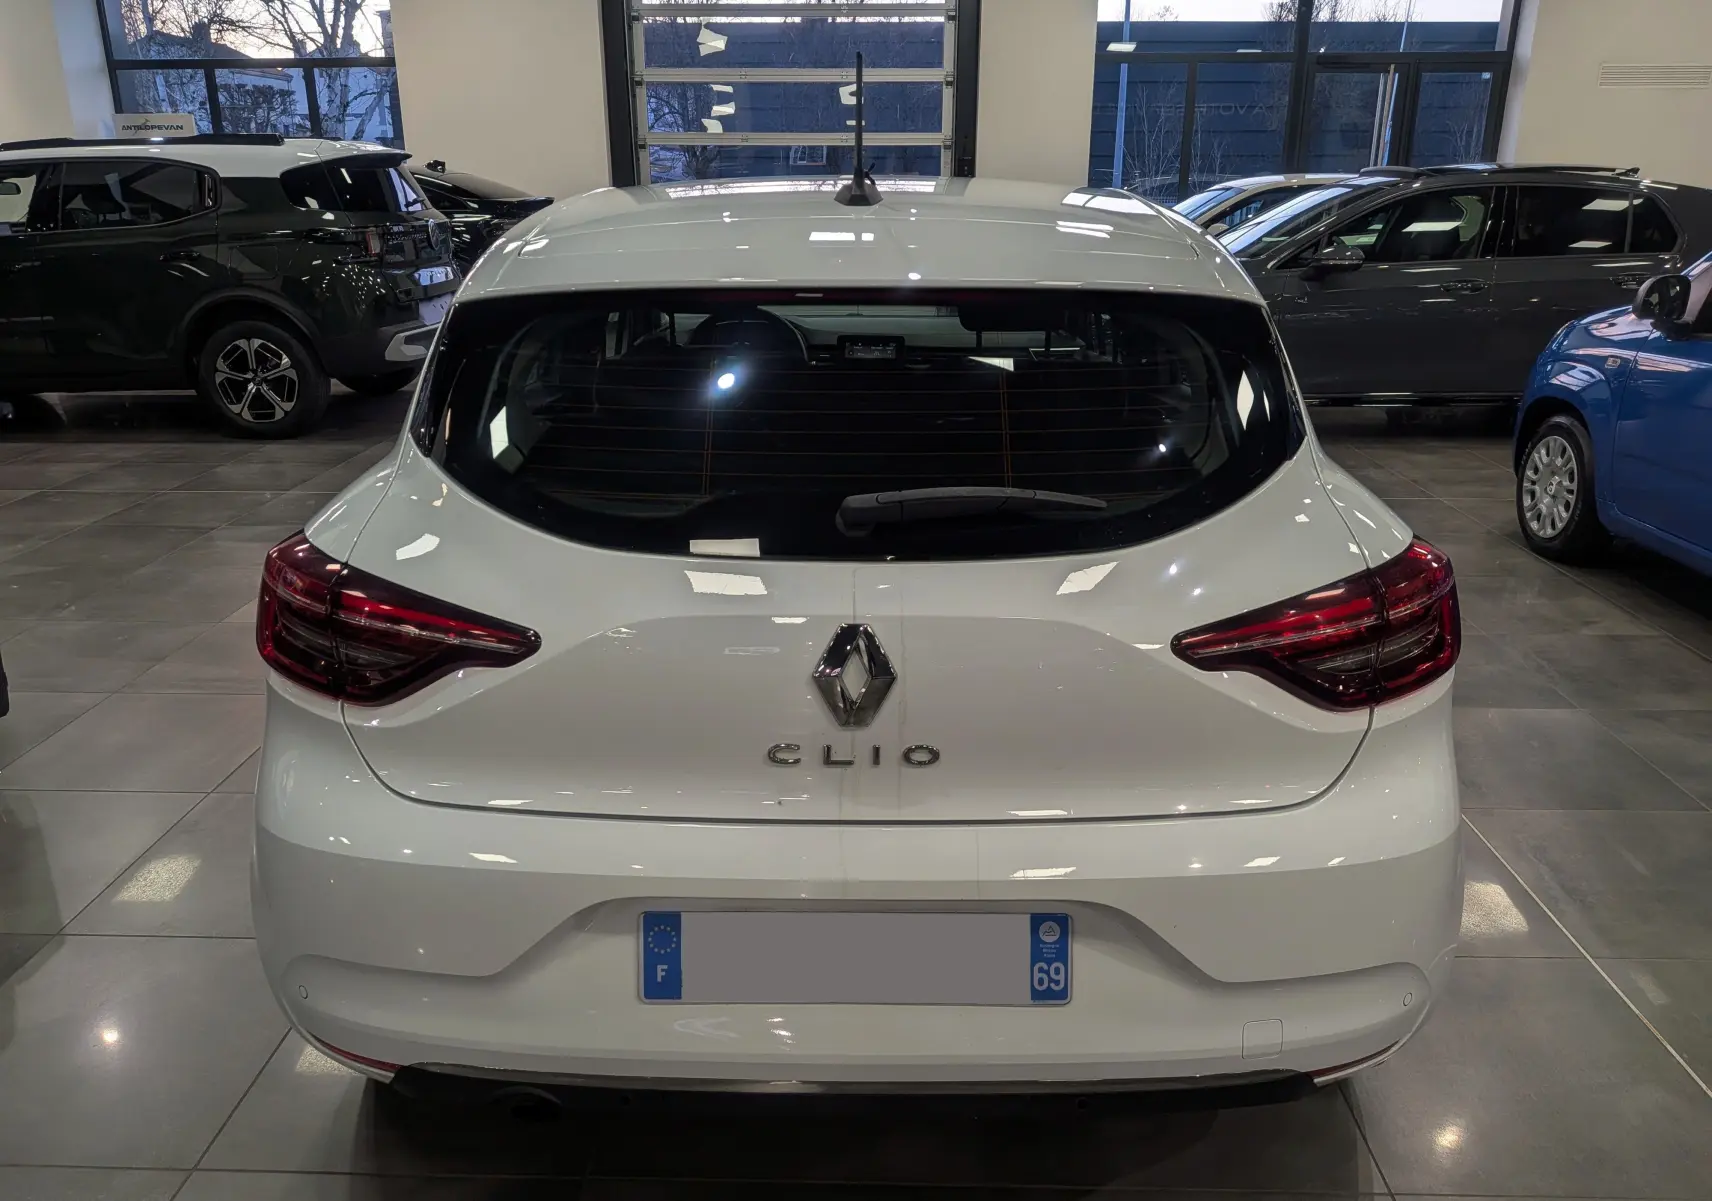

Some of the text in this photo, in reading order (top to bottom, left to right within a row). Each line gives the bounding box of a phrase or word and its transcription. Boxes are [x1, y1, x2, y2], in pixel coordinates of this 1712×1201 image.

[767, 743, 941, 766] CLIO
[656, 964, 669, 983] F
[1033, 961, 1065, 991] 69
